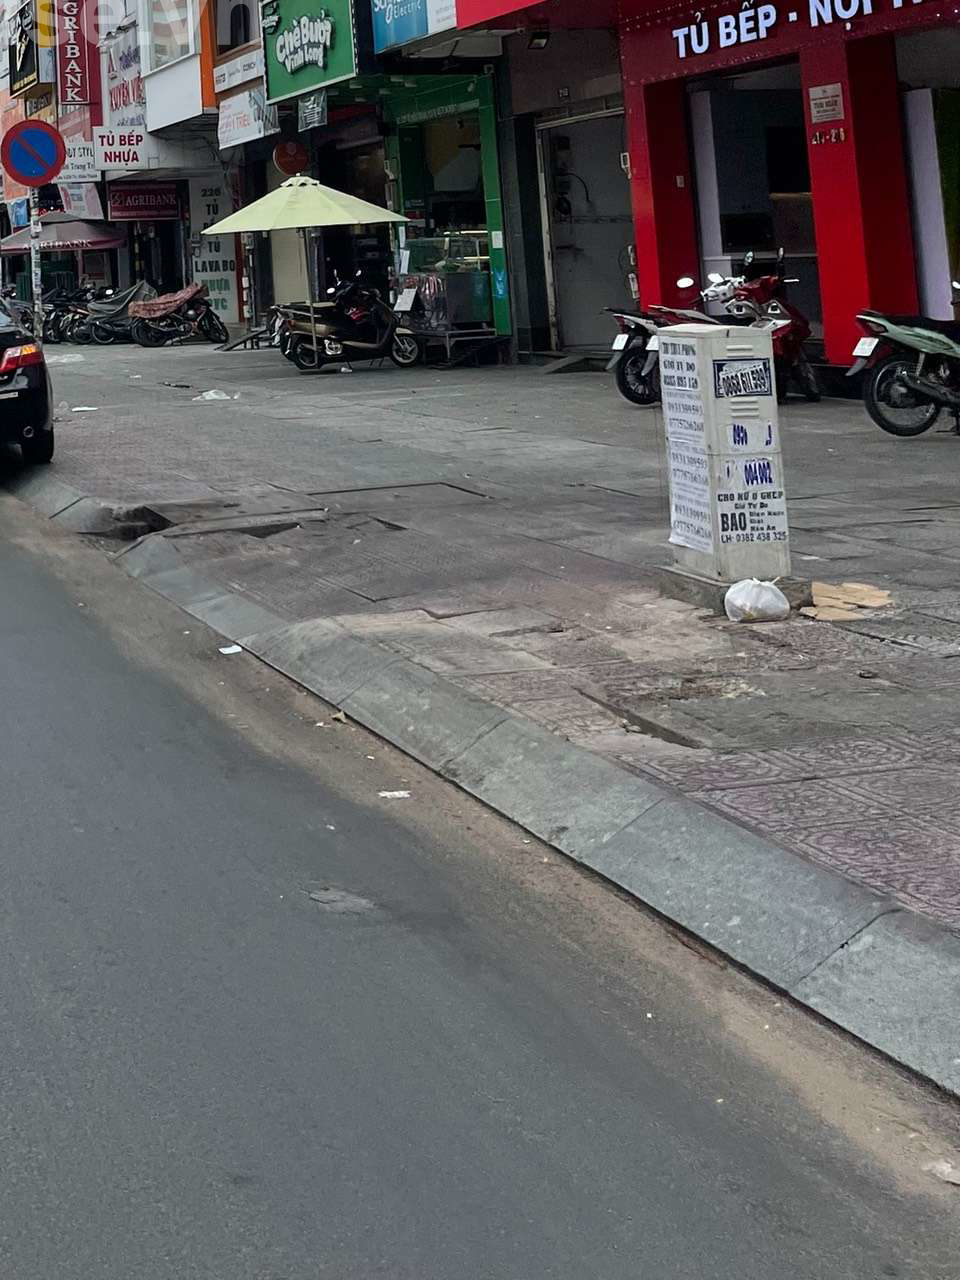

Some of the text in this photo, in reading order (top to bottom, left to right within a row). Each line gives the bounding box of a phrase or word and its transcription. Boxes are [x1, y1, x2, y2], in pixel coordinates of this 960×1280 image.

[672, 11, 710, 59] TỦ
[98, 129, 144, 147] TỦ BẾP
[104, 148, 140, 166] NHỰA
[126, 193, 178, 207] AGRIBANK
[720, 512, 748, 532] BAO
